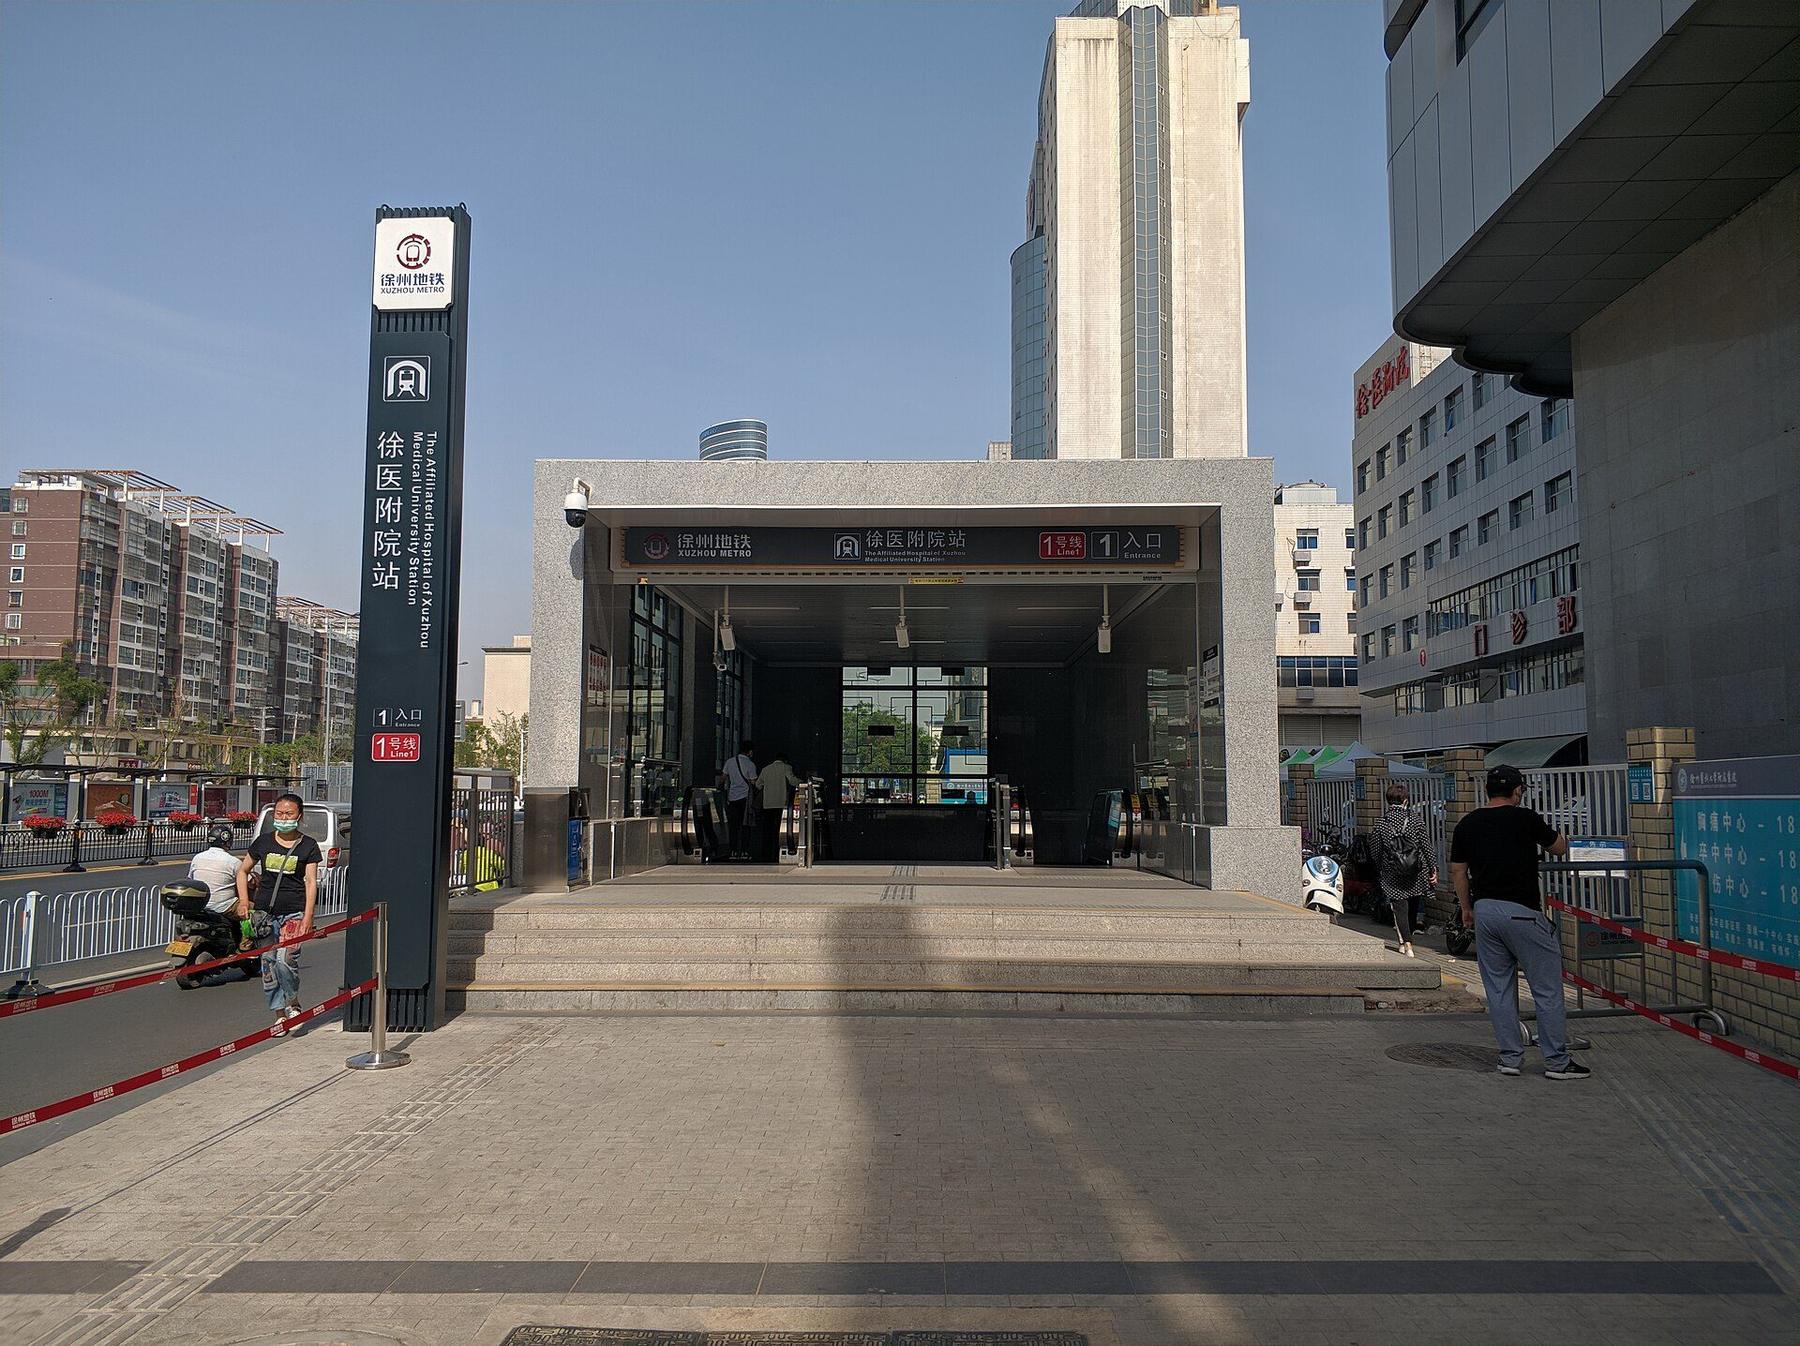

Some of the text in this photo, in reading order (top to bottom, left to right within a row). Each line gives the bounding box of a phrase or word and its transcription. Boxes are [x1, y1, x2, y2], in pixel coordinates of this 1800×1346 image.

[380, 272, 445, 287] 徐州地铁
[380, 286, 445, 295] XUZHOU METRO
[371, 431, 405, 590] 徐医附院站
[407, 431, 424, 606] Medical University Station
[420, 431, 437, 649] The Affiliated Hospital of Xuzhou
[677, 533, 751, 549] 徐州地铁
[865, 529, 967, 548] 徐医附院站
[1043, 535, 1083, 555] 1号线
[1099, 534, 1110, 556] 1
[1123, 532, 1161, 549] 入口
[678, 549, 752, 558] XUZHOU METRO
[906, 550, 933, 558] Hospital
[1057, 548, 1080, 556] Line1
[1124, 551, 1161, 559] Entrance
[1473, 596, 1576, 657] 门诊部
[378, 709, 387, 725] 1
[395, 708, 422, 721] 入口
[376, 737, 416, 757] 1号线
[390, 750, 414, 758] Line1
[1697, 811, 1746, 833] 胸痛中心
[1698, 842, 1748, 865] 卒中中心
